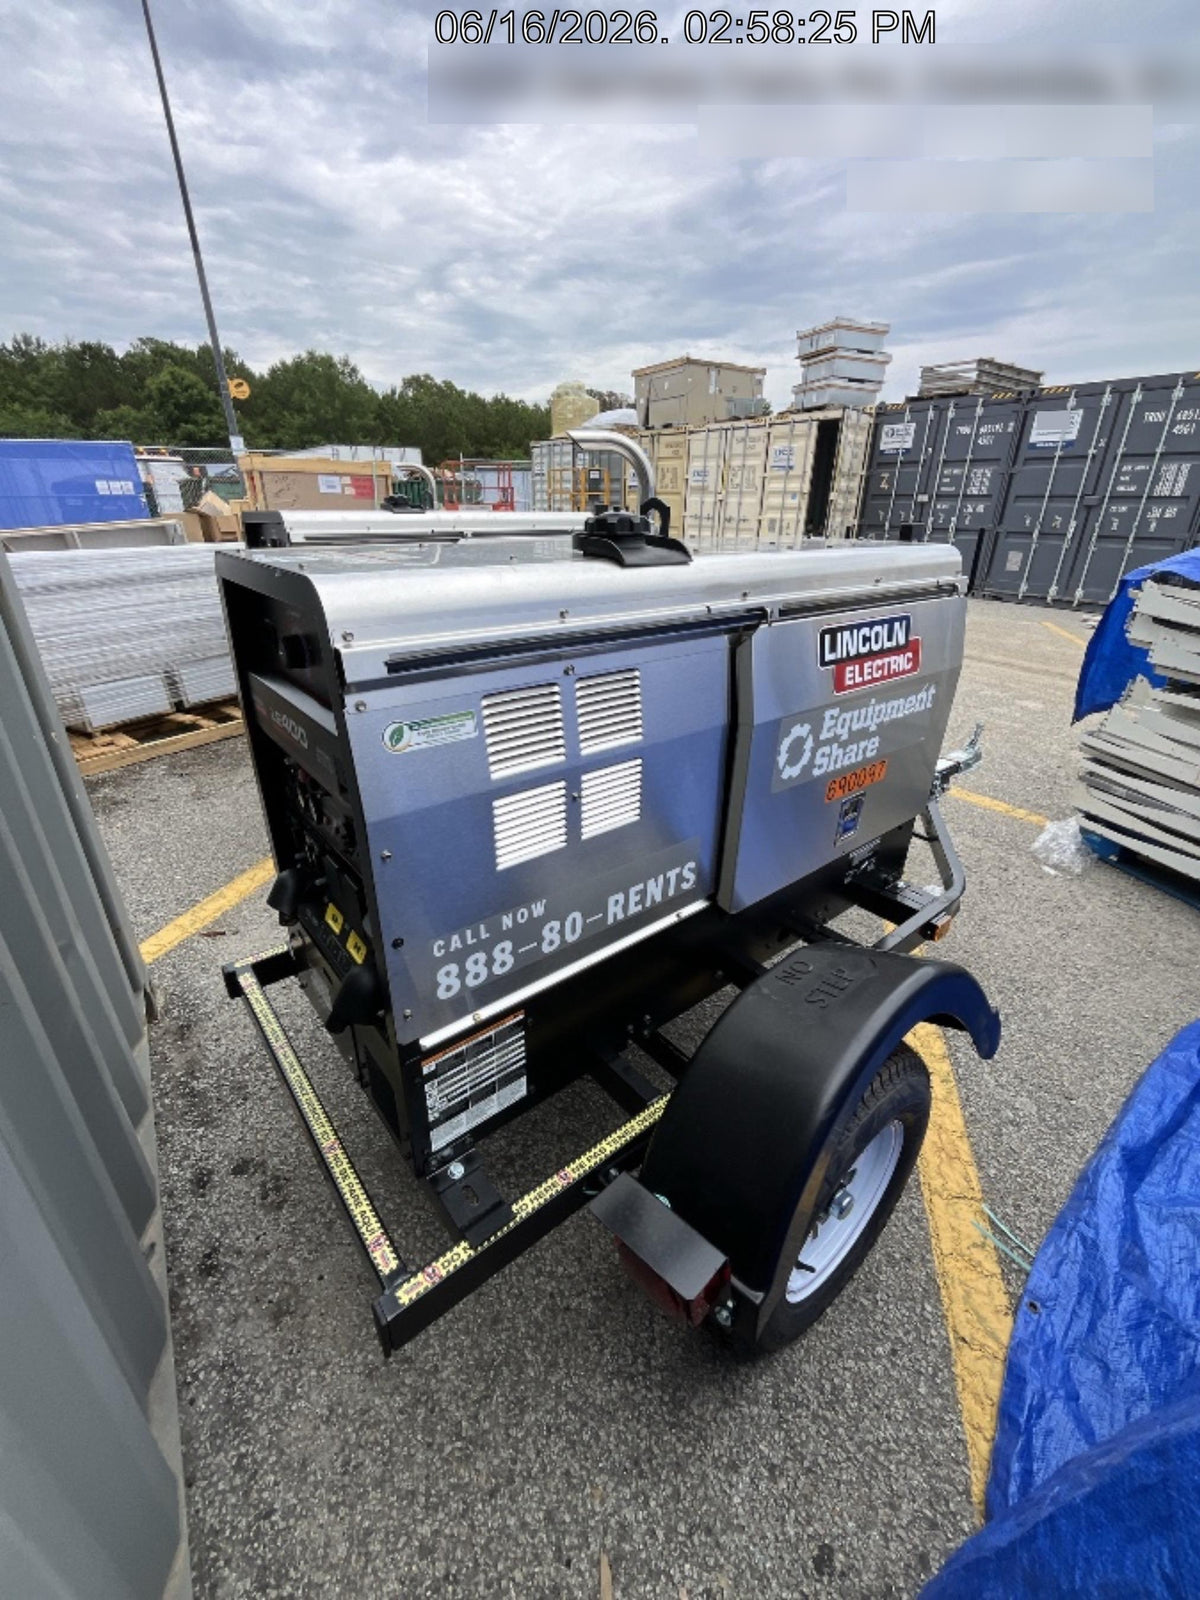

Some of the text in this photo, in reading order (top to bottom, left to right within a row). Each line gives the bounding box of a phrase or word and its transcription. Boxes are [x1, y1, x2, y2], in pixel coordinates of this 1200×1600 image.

[824, 619, 909, 662] LINCOLN
[844, 652, 913, 687] ELECTRIC
[819, 683, 937, 742] Equipment
[811, 735, 880, 778] Share
[432, 898, 548, 958] CALL NOW
[775, 960, 813, 986] NO
[804, 968, 854, 1009] STEP
[345, 1181, 363, 1210] PARE
